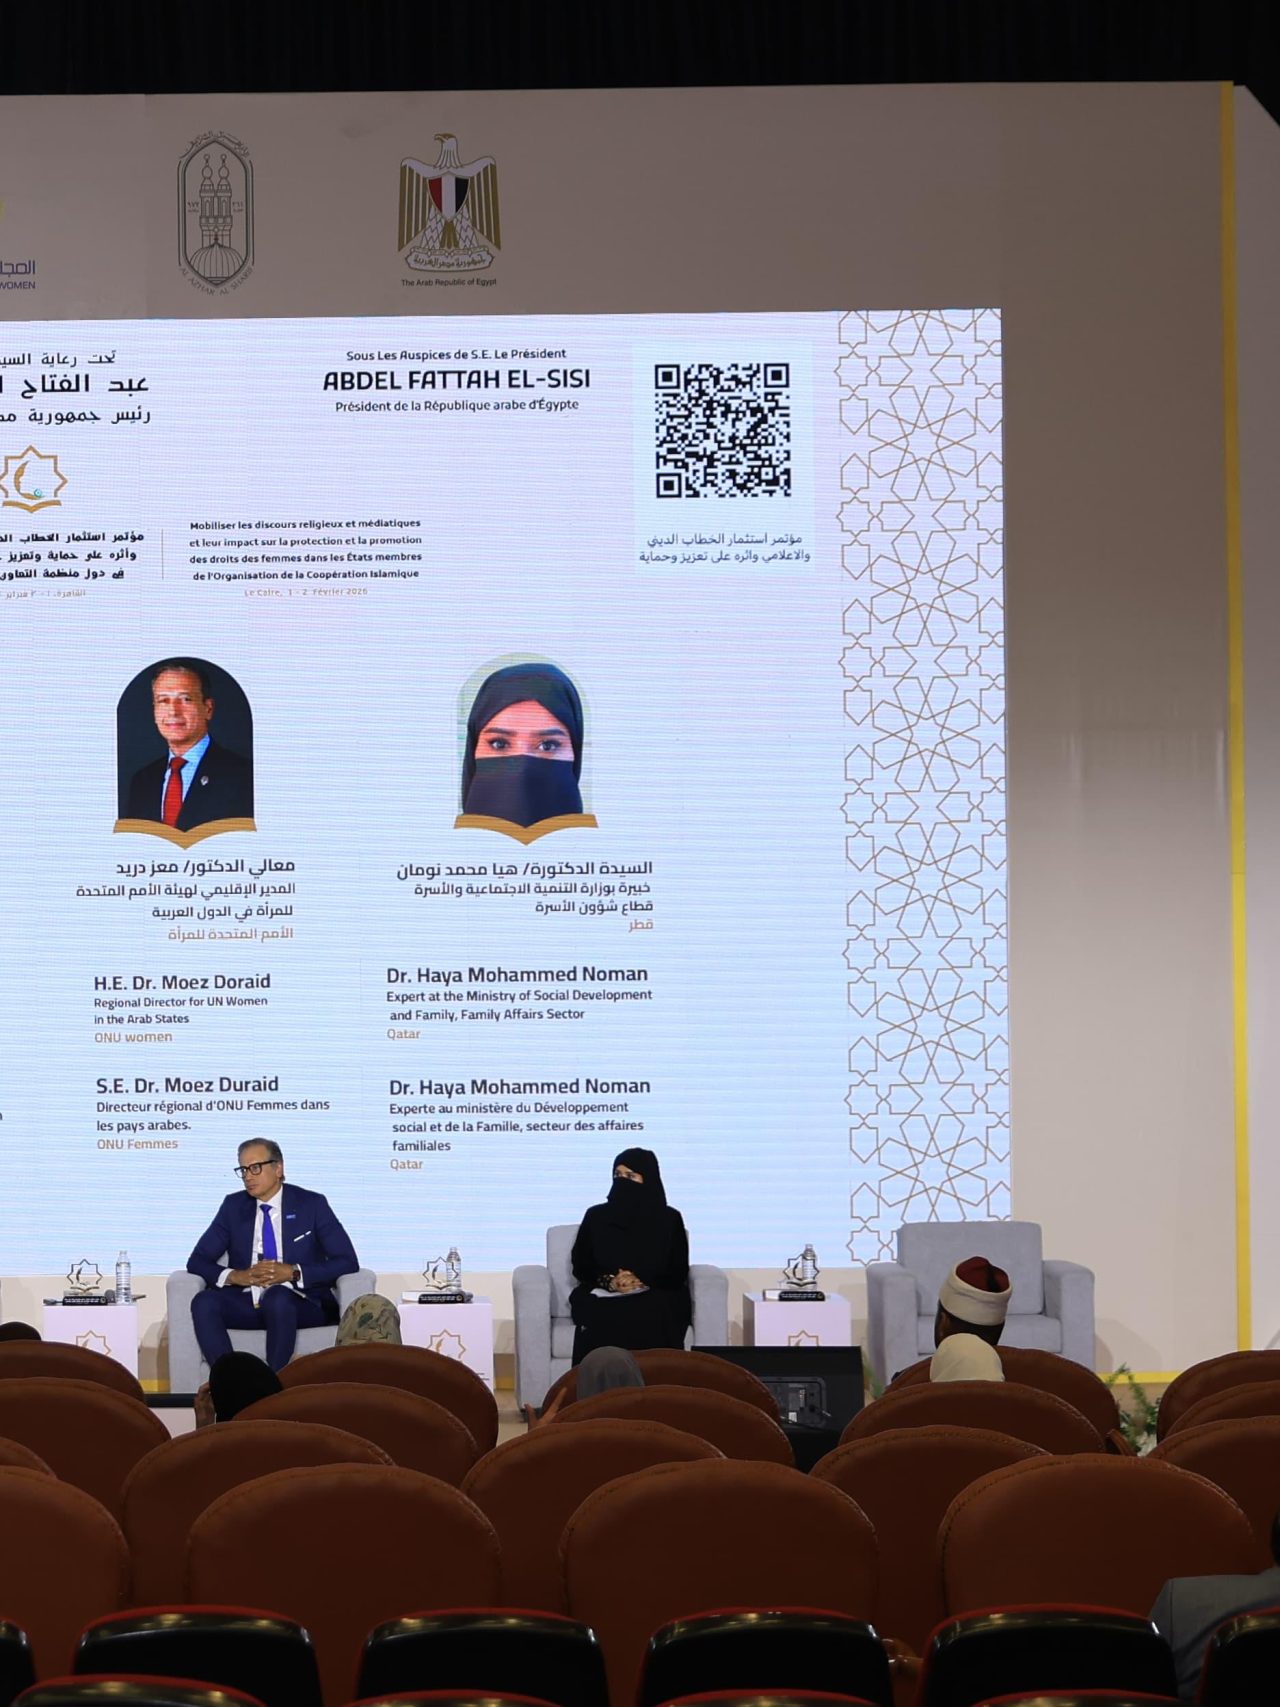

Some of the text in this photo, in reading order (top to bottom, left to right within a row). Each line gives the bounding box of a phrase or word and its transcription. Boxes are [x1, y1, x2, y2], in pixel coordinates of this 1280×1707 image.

[401, 277, 497, 288] The Arab Republic of Egypt
[346, 348, 567, 363] Sous Les Auspices de S.E. Le Président
[20, 373, 90, 400] الفتاح
[107, 377, 149, 397] عبد
[323, 368, 590, 391] ABDEL FATTAH EL-SISI
[110, 405, 151, 425] رئيس
[335, 397, 579, 414] Président de la République arabe d'Égypte
[28, 408, 101, 426] جمهورية
[190, 518, 421, 531] Mobiliser les discours religieux et médiatiques
[116, 858, 295, 879] معالي الدكتور/ معز دريد
[396, 861, 653, 881] السيدة الدكتورة/ هيا محمد نومان
[94, 972, 271, 991] H.E. Dr. Moez Doraid
[387, 965, 648, 986] Dr. Haya Mohammed Noman
[93, 996, 268, 1011] Regional Director for UN Women
[386, 989, 653, 1005] Expert at the Ministry of Social Development
[94, 1031, 173, 1044] ONU women
[386, 1028, 421, 1041] Qatar
[96, 1075, 279, 1094] S.E. Dr. Moez Duraid
[389, 1077, 651, 1098] Dr. Haya Mohammed Noman
